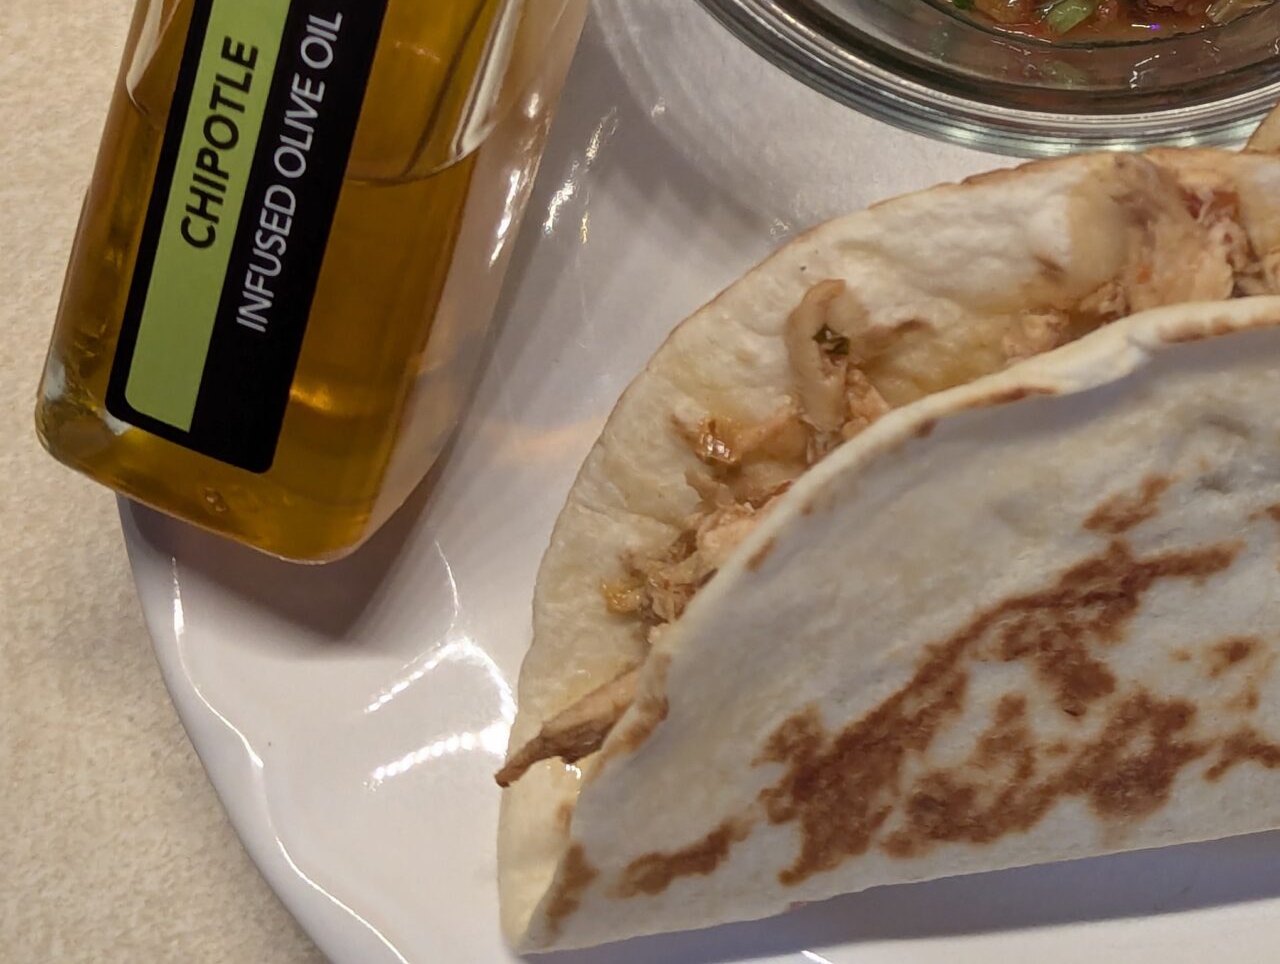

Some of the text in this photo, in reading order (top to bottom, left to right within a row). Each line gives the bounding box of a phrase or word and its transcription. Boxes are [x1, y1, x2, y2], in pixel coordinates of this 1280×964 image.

[180, 36, 259, 250] CHIPOTLE
[236, 10, 343, 333] INFUSED OLIVE OIL
